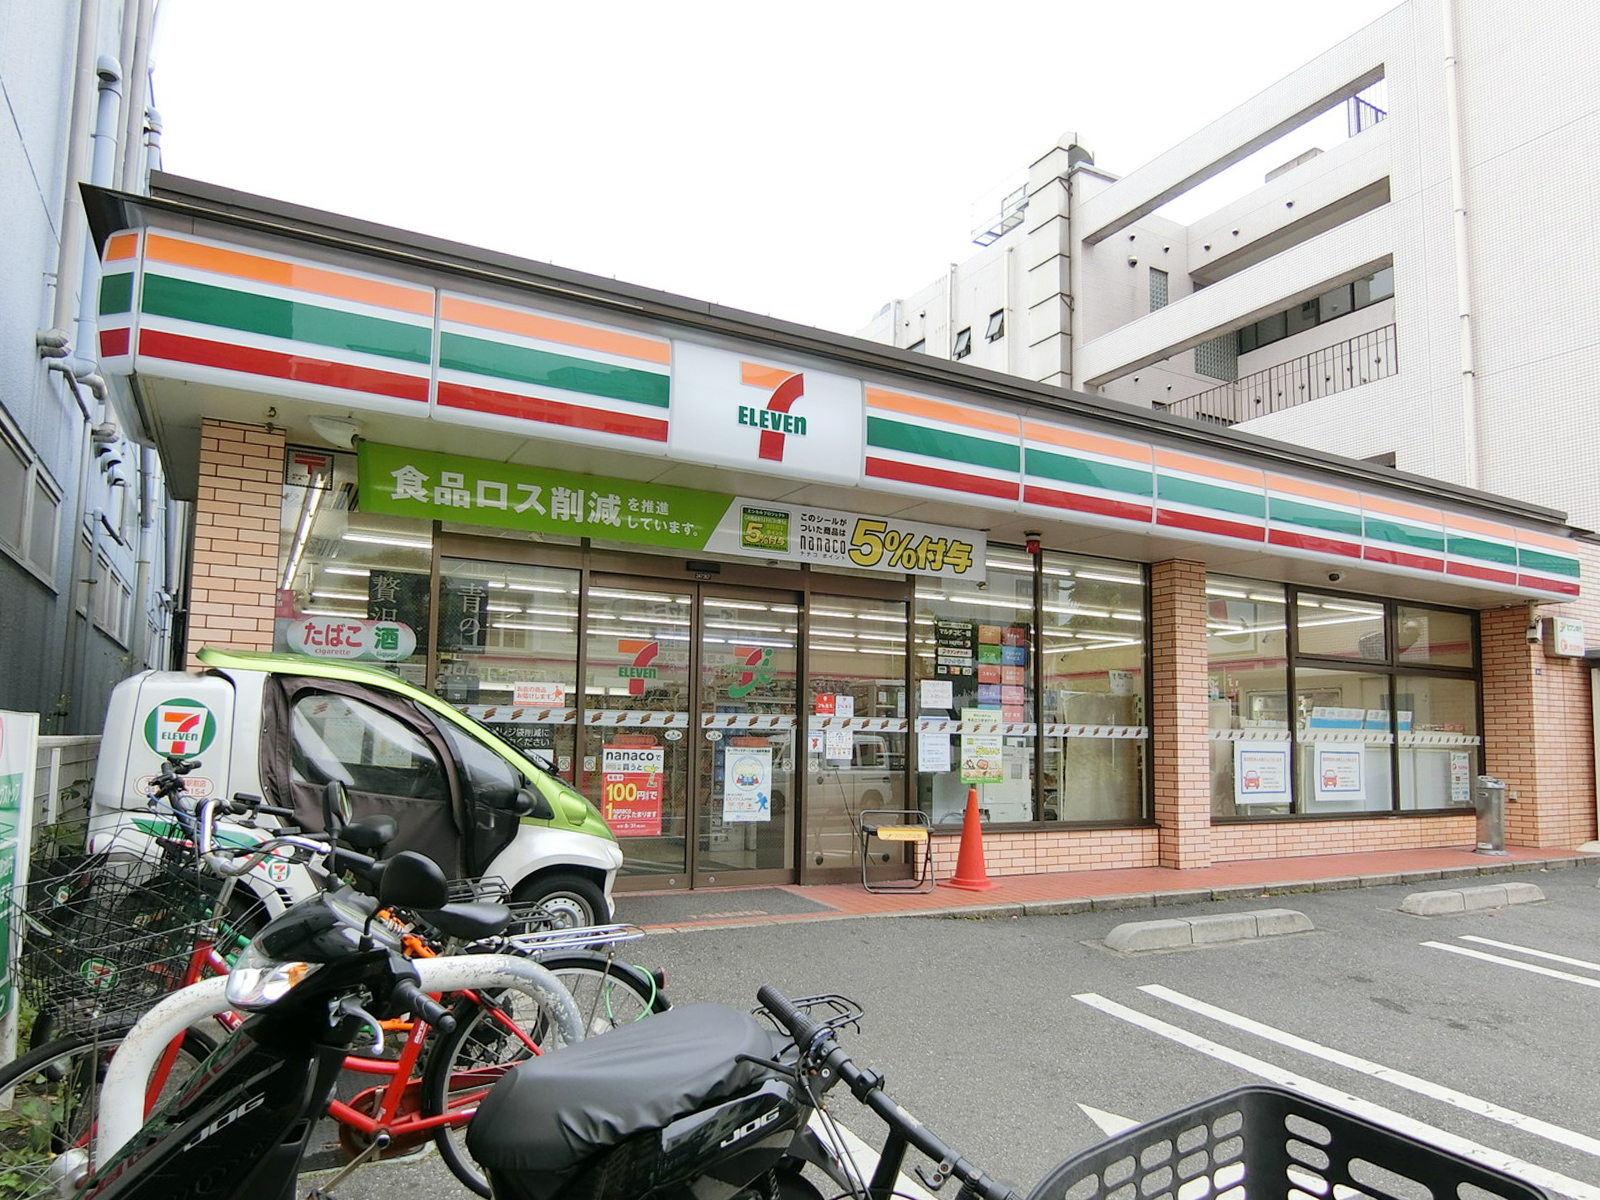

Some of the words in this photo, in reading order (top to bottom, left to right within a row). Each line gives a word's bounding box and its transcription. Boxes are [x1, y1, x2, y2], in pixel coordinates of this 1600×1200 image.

[391, 465, 621, 527] 食品ロス削減
[628, 498, 669, 515] を推進
[627, 515, 699, 537] しています。
[800, 513, 847, 527] このシールが
[800, 524, 847, 537] ついた商品は
[800, 535, 846, 555] nanaco
[848, 518, 973, 574] 5%付与
[304, 622, 362, 648] たばこ
[374, 626, 400, 651] 酒
[315, 648, 351, 656] cigarette
[183, 1091, 265, 1152] JOG
[720, 1106, 779, 1148] JOG
